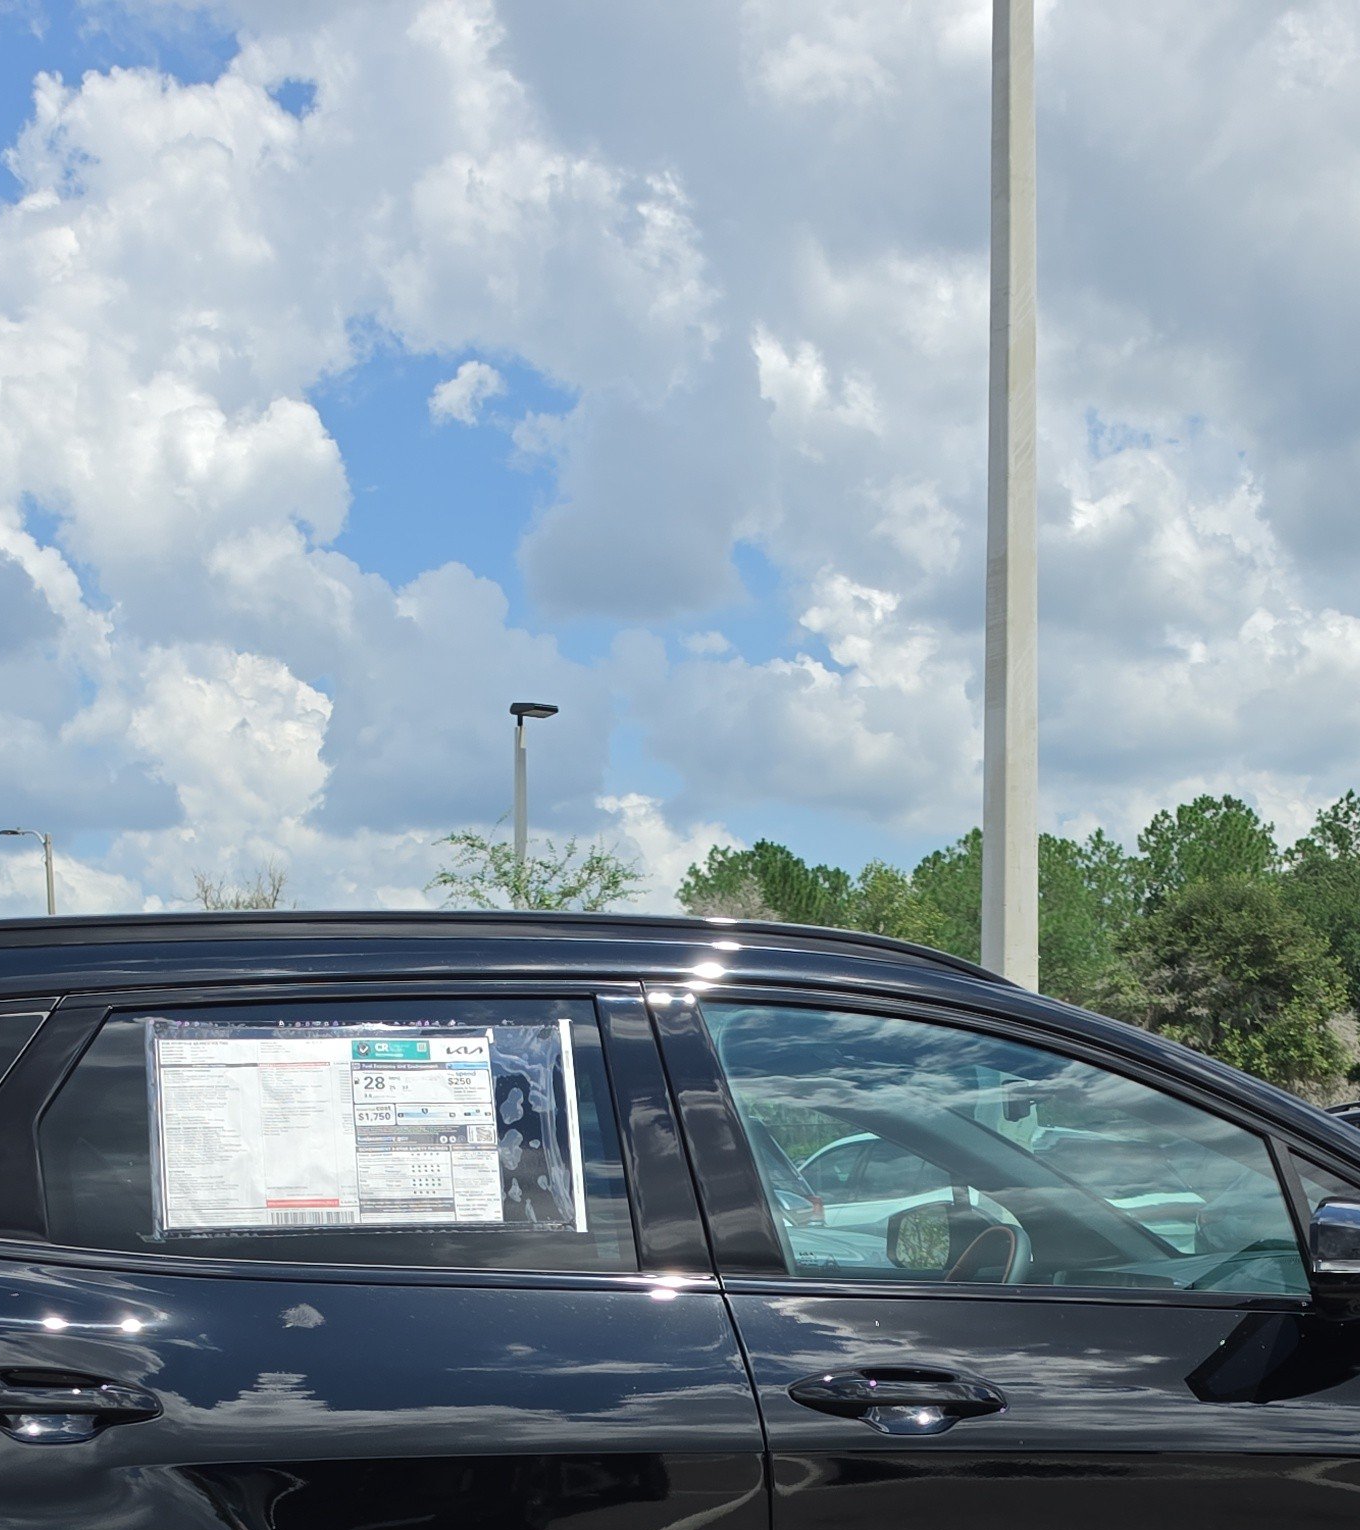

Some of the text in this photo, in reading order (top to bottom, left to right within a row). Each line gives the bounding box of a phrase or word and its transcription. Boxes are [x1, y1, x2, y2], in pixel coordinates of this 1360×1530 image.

[363, 1076, 386, 1090] 28
[447, 1077, 472, 1085] $250
[358, 1112, 391, 1122] $1,750
